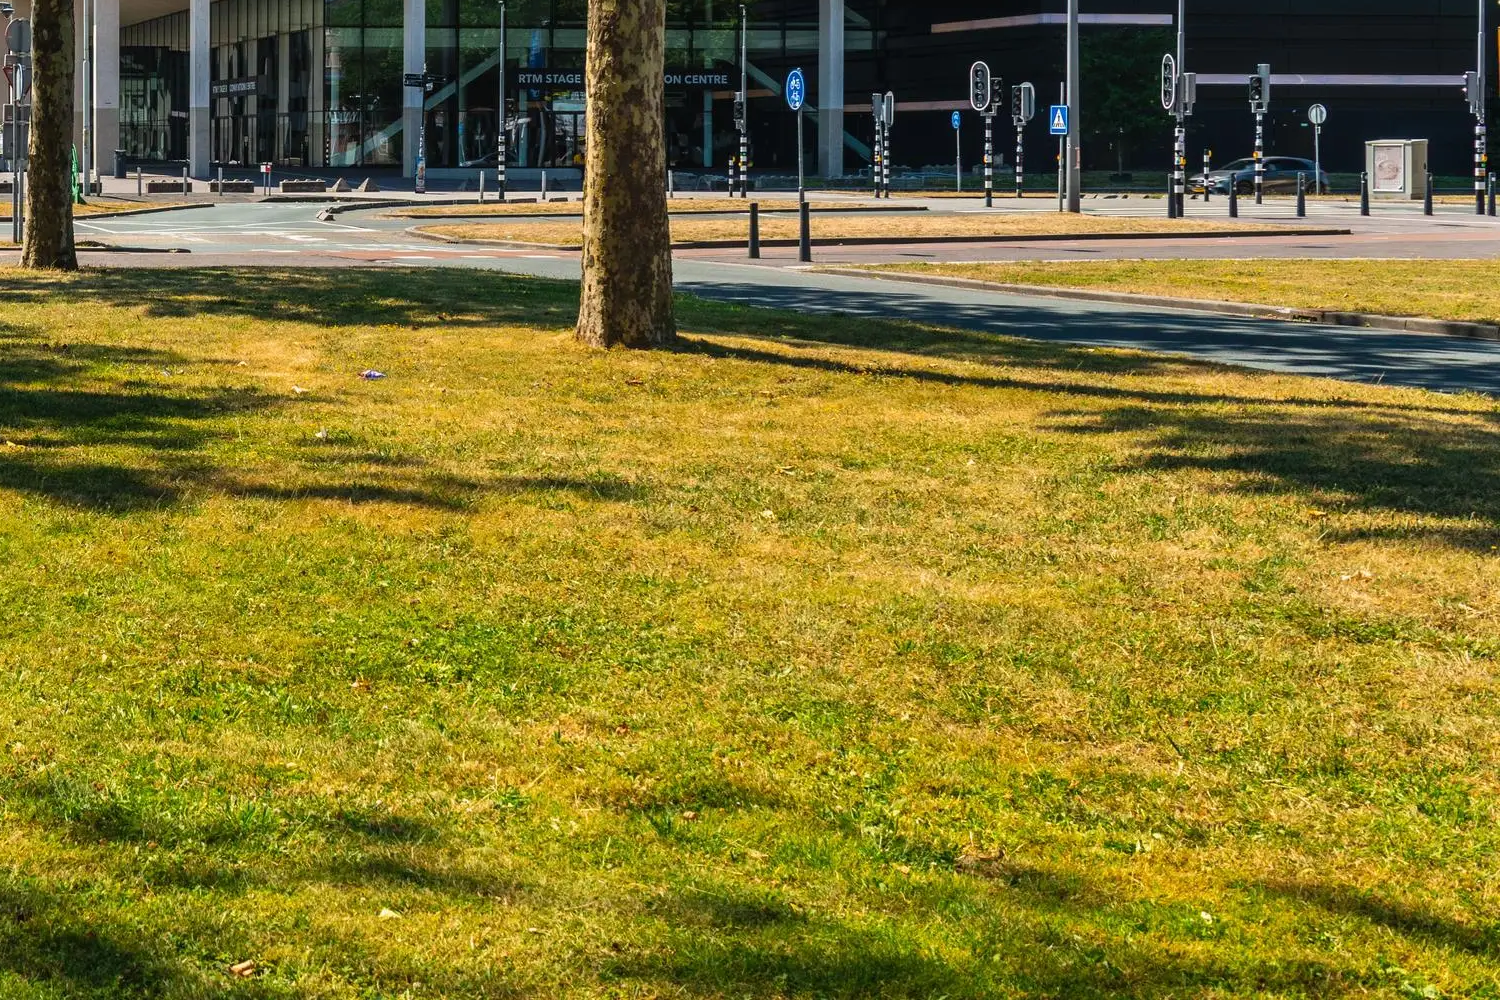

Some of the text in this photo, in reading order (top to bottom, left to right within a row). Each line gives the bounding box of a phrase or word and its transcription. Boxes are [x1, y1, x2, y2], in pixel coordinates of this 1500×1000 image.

[518, 74, 581, 84] RTM STAGE
[684, 75, 728, 84] CENTRE
